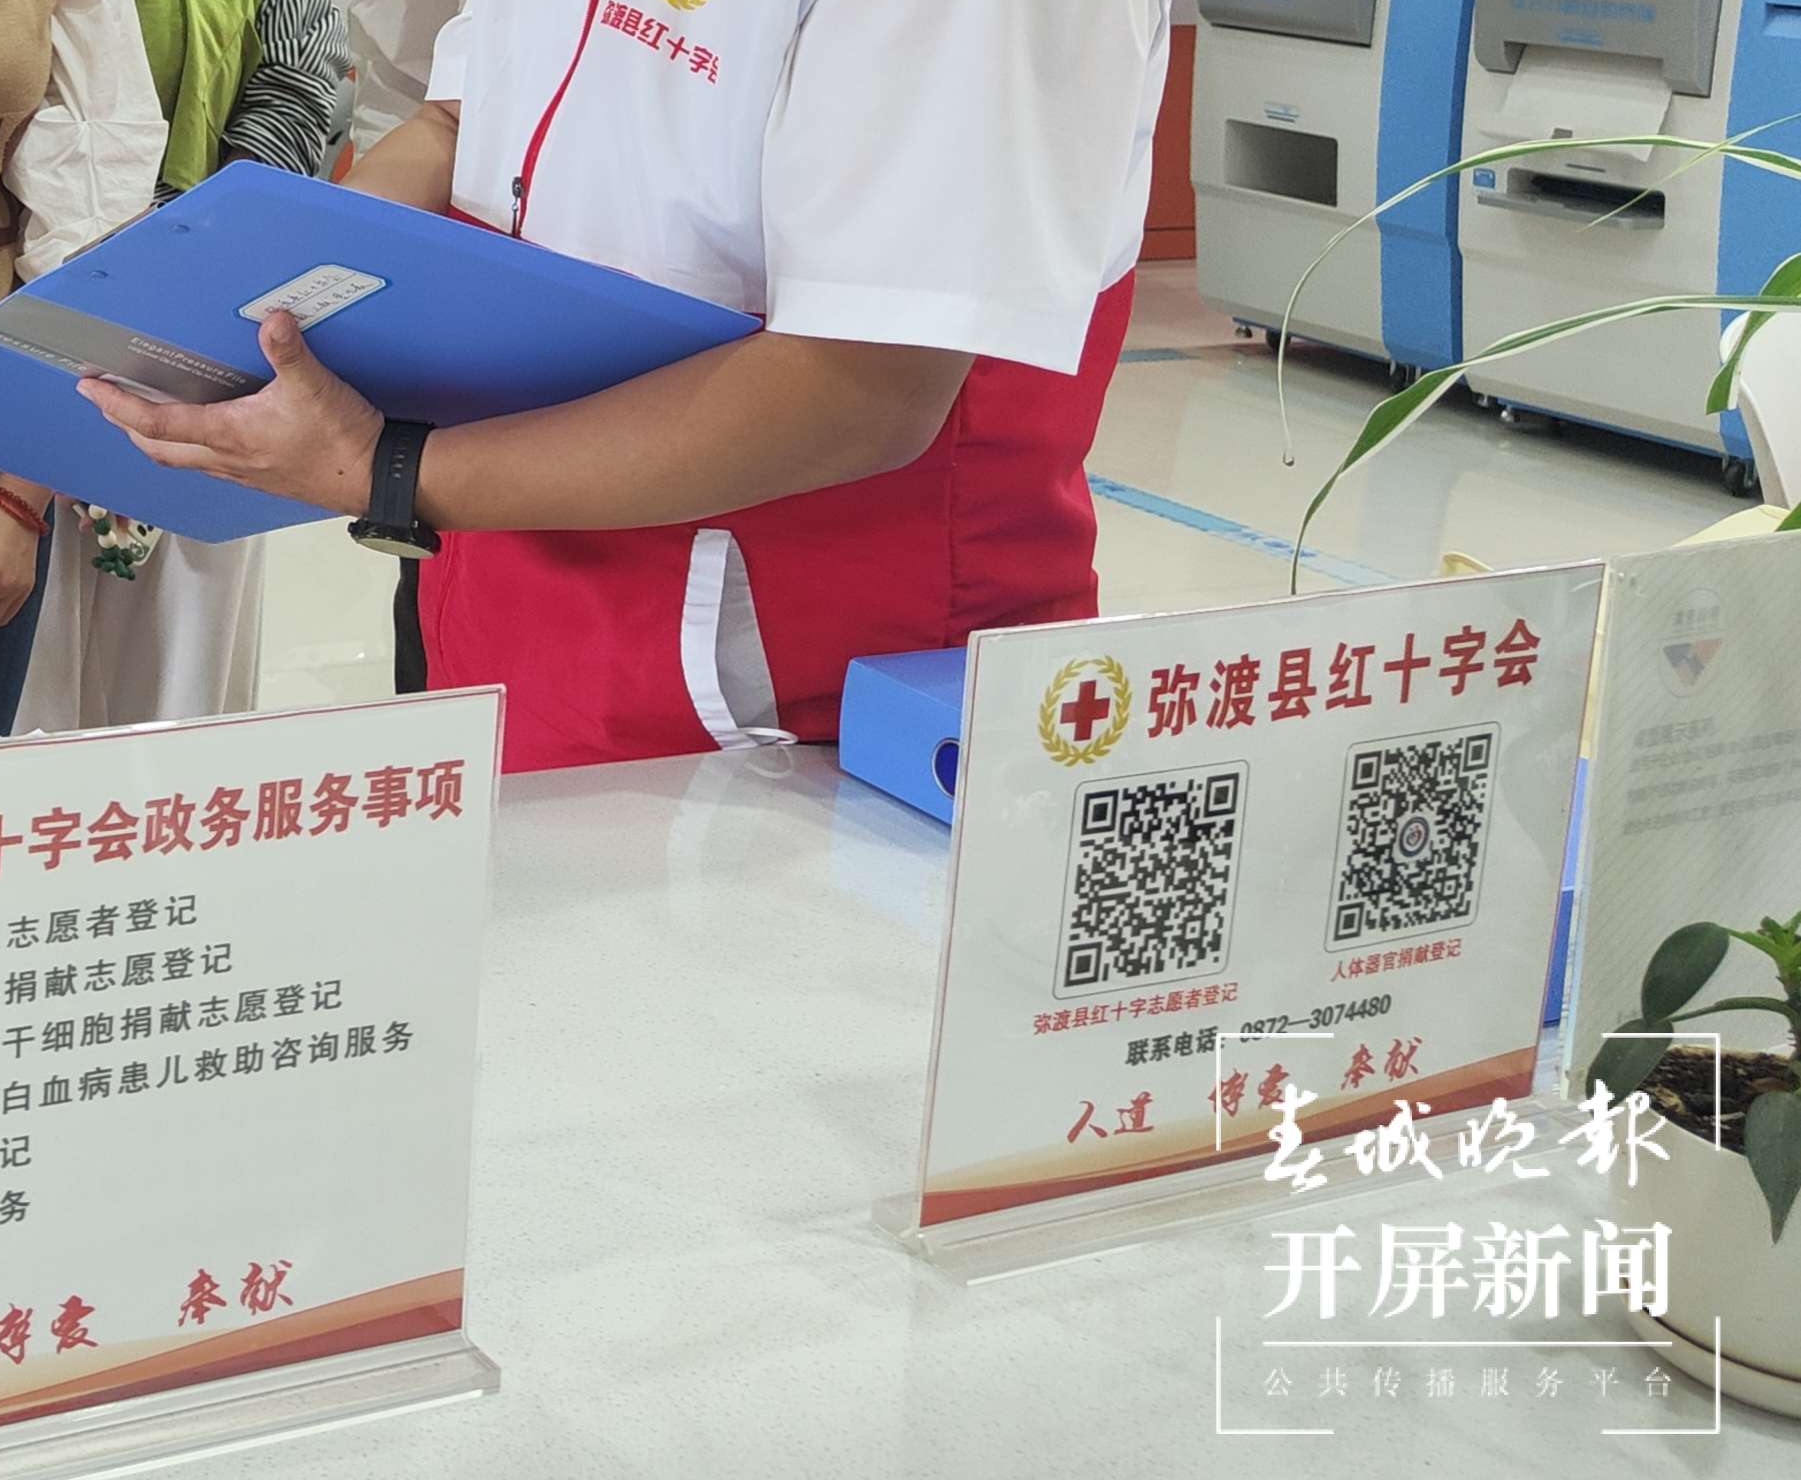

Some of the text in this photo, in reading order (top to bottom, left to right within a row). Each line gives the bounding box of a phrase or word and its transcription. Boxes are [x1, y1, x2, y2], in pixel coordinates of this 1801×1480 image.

[1147, 618, 1541, 738] 弥渡县红十字会
[1330, 938, 1462, 983] 人体器官捐献登记
[1033, 982, 1239, 1036] 弥渡县红十字志愿者登记
[1067, 1091, 1155, 1144] 人道
[1340, 1036, 1425, 1091] 奉献
[177, 1259, 294, 1327] 奉献
